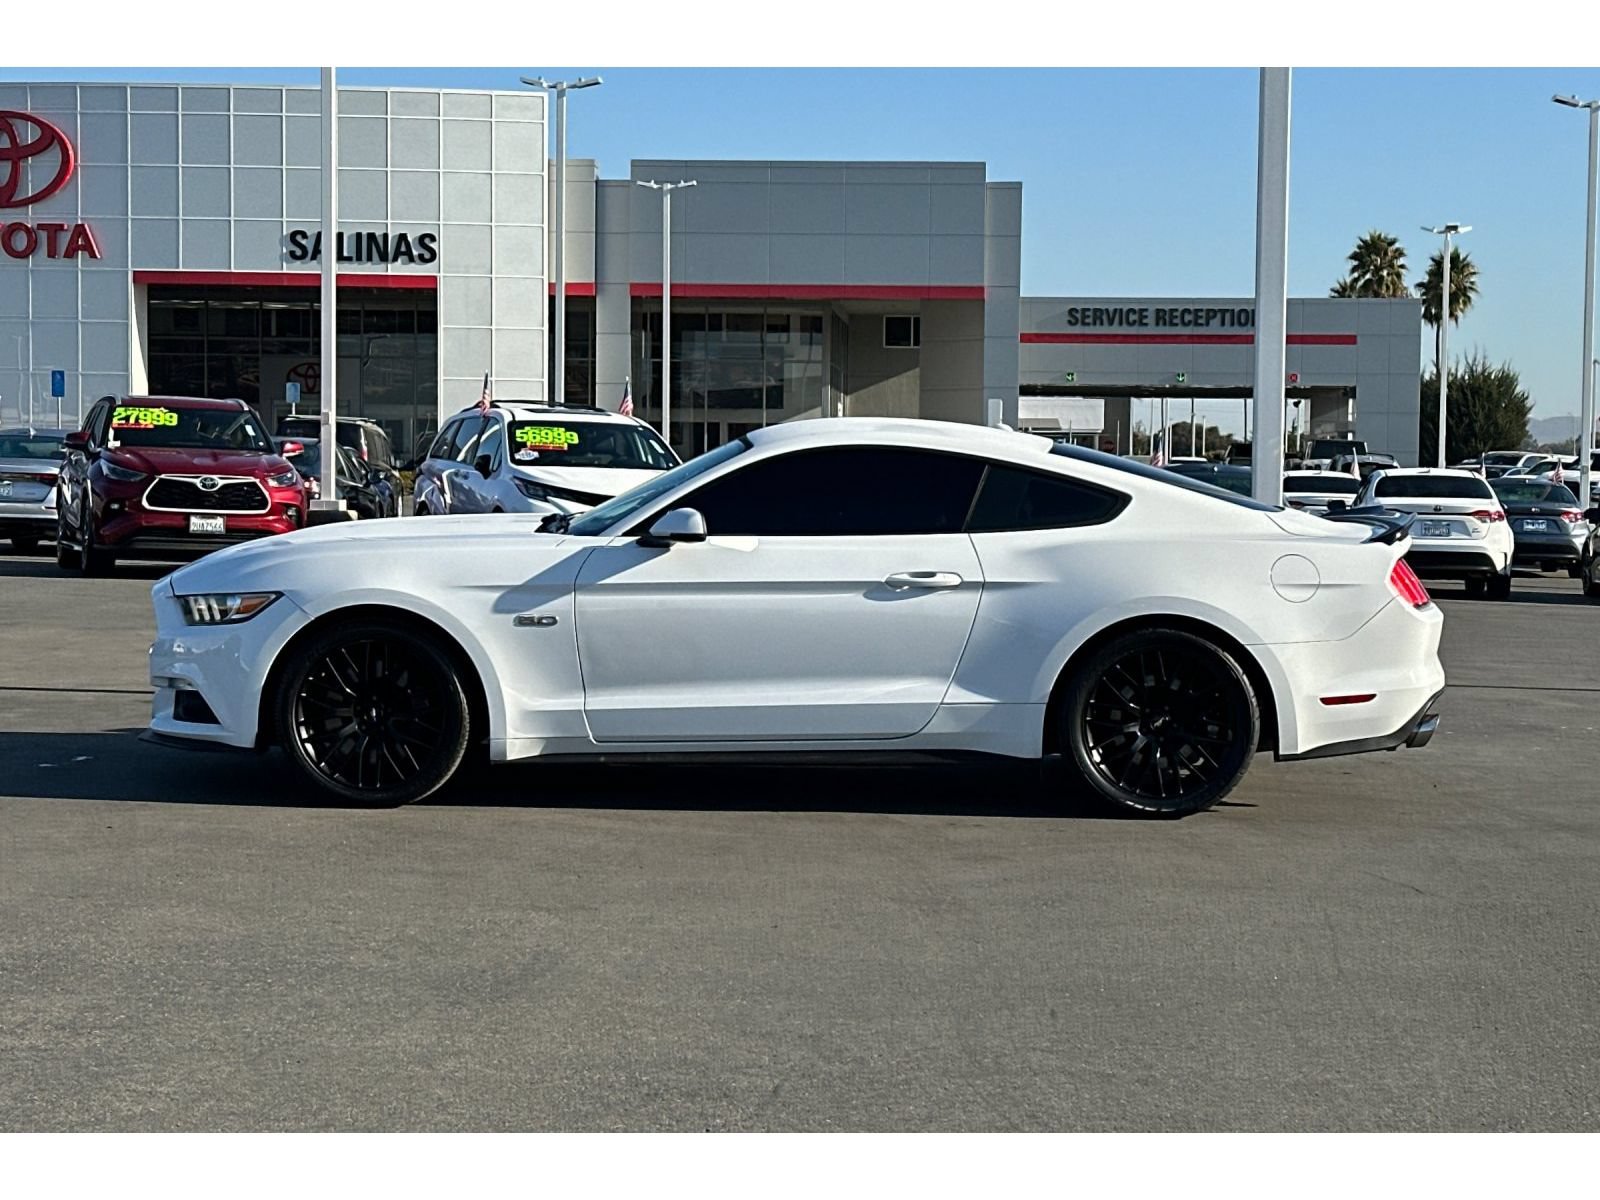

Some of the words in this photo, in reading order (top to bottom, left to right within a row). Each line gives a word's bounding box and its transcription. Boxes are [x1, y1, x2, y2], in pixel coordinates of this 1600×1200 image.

[0, 222, 102, 259] OTA
[1067, 307, 1149, 327] SERVICE
[1155, 308, 1256, 327] RECEPTIO
[112, 409, 179, 426] 27999
[515, 428, 579, 444] 56999
